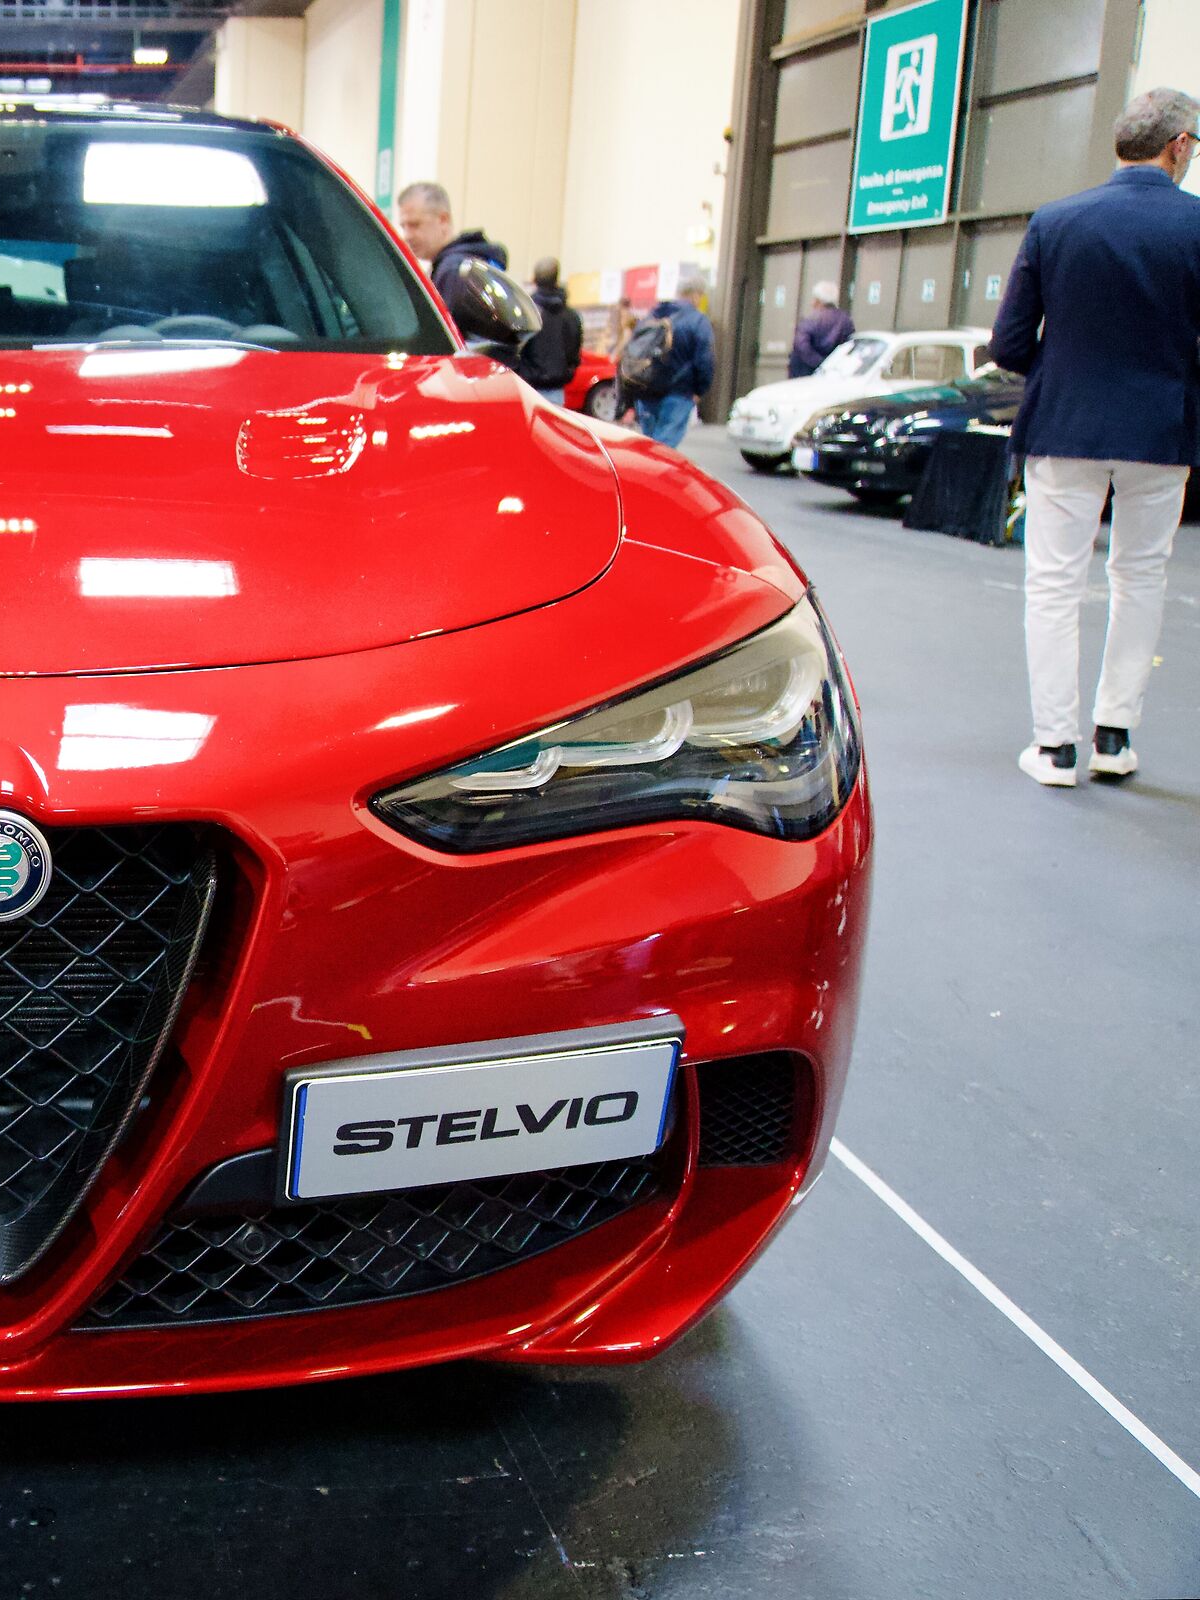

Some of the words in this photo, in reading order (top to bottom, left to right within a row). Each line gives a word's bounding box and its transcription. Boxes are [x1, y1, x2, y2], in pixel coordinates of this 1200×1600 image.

[859, 172, 884, 189] Uscita
[885, 169, 894, 185] di
[894, 164, 943, 184] Emergenza
[866, 200, 910, 216] Emergency
[911, 193, 928, 210] Exit
[332, 1090, 640, 1156] STELVIO
